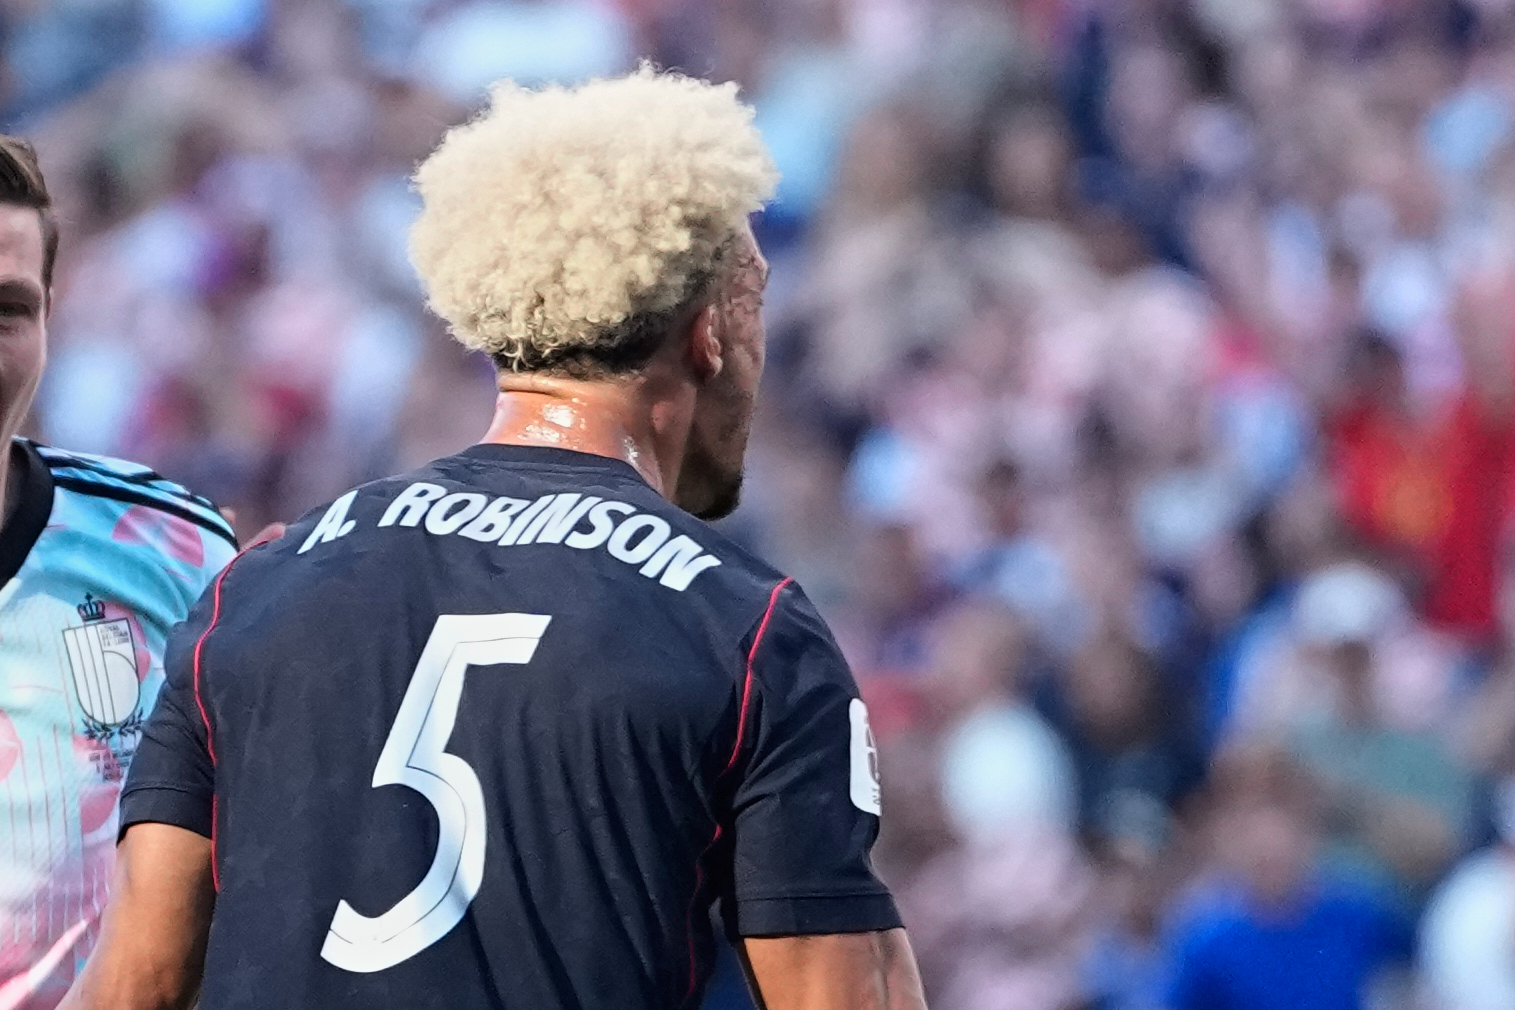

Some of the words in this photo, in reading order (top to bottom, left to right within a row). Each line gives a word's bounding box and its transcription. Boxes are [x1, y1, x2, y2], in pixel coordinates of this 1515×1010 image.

[296, 490, 359, 556] A.
[379, 480, 722, 593] ROBINSON
[320, 612, 552, 974] 5
